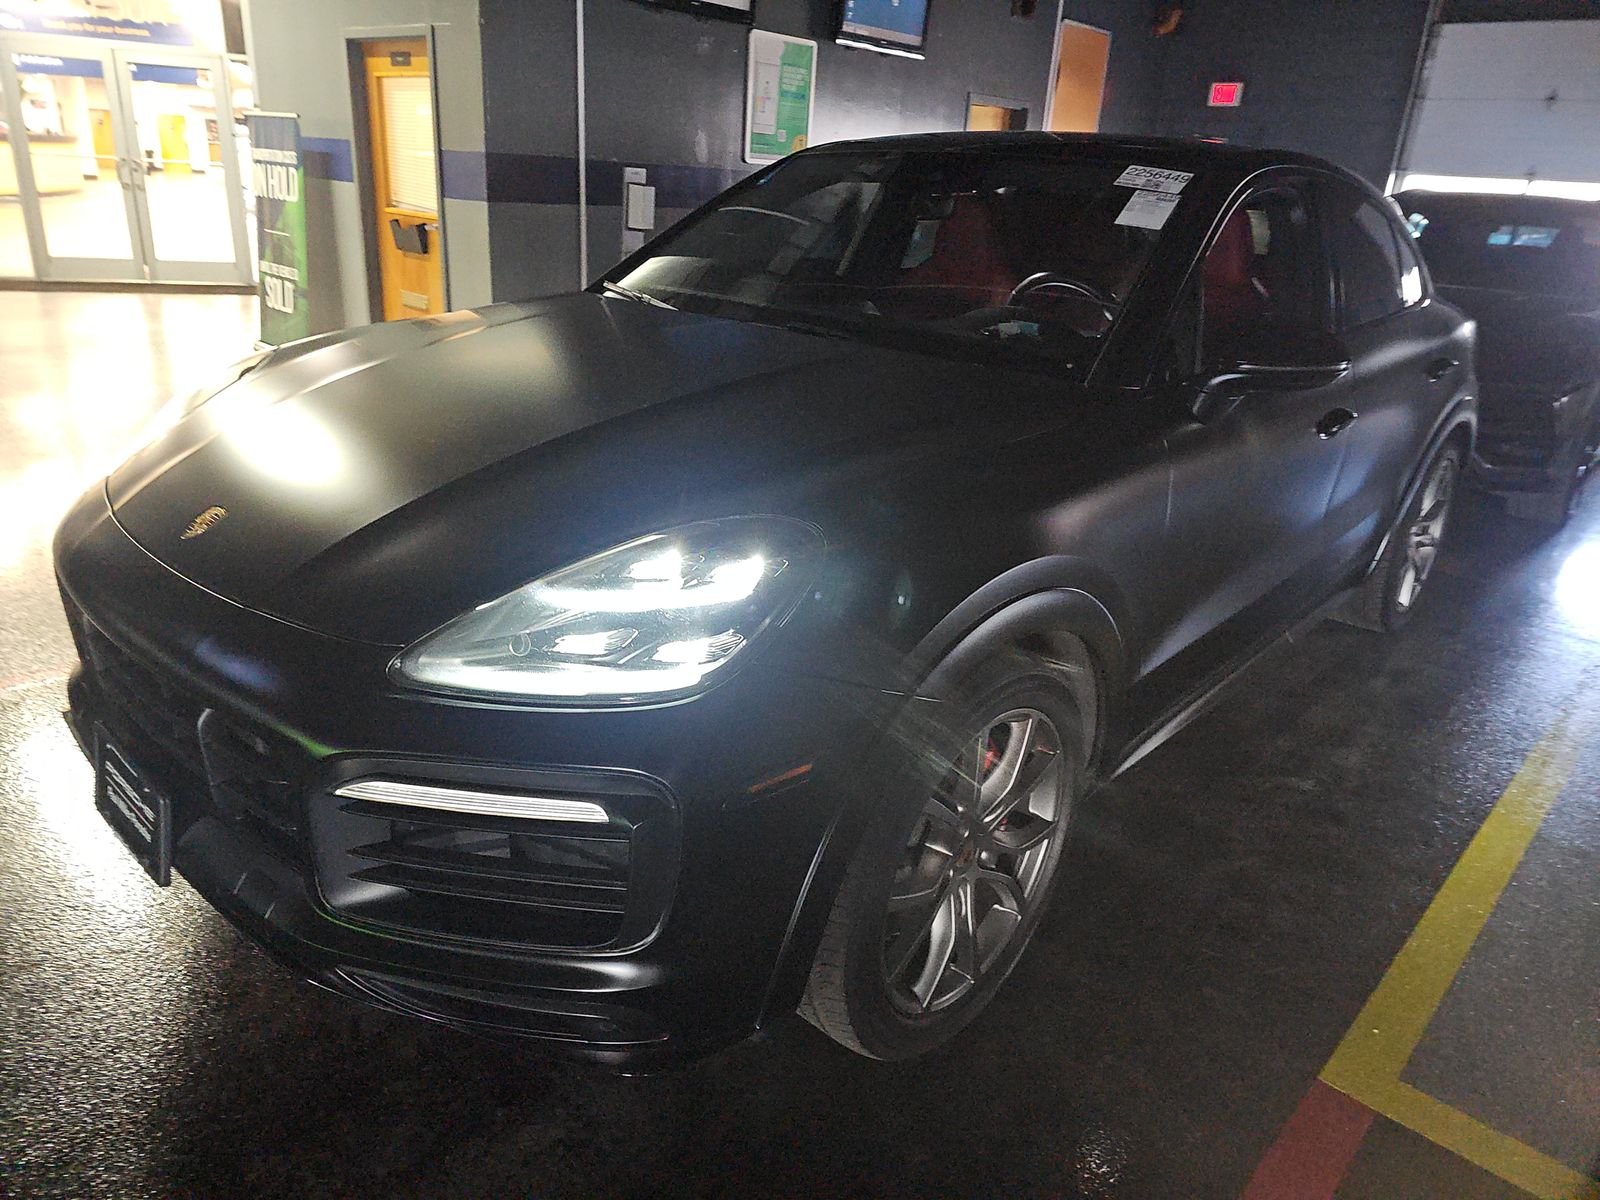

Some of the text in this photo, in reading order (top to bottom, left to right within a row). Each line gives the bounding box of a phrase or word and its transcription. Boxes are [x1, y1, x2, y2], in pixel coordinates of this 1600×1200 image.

[267, 164, 298, 202] HOLD
[1125, 167, 1191, 184] 2256449
[264, 276, 294, 314] SOLD
